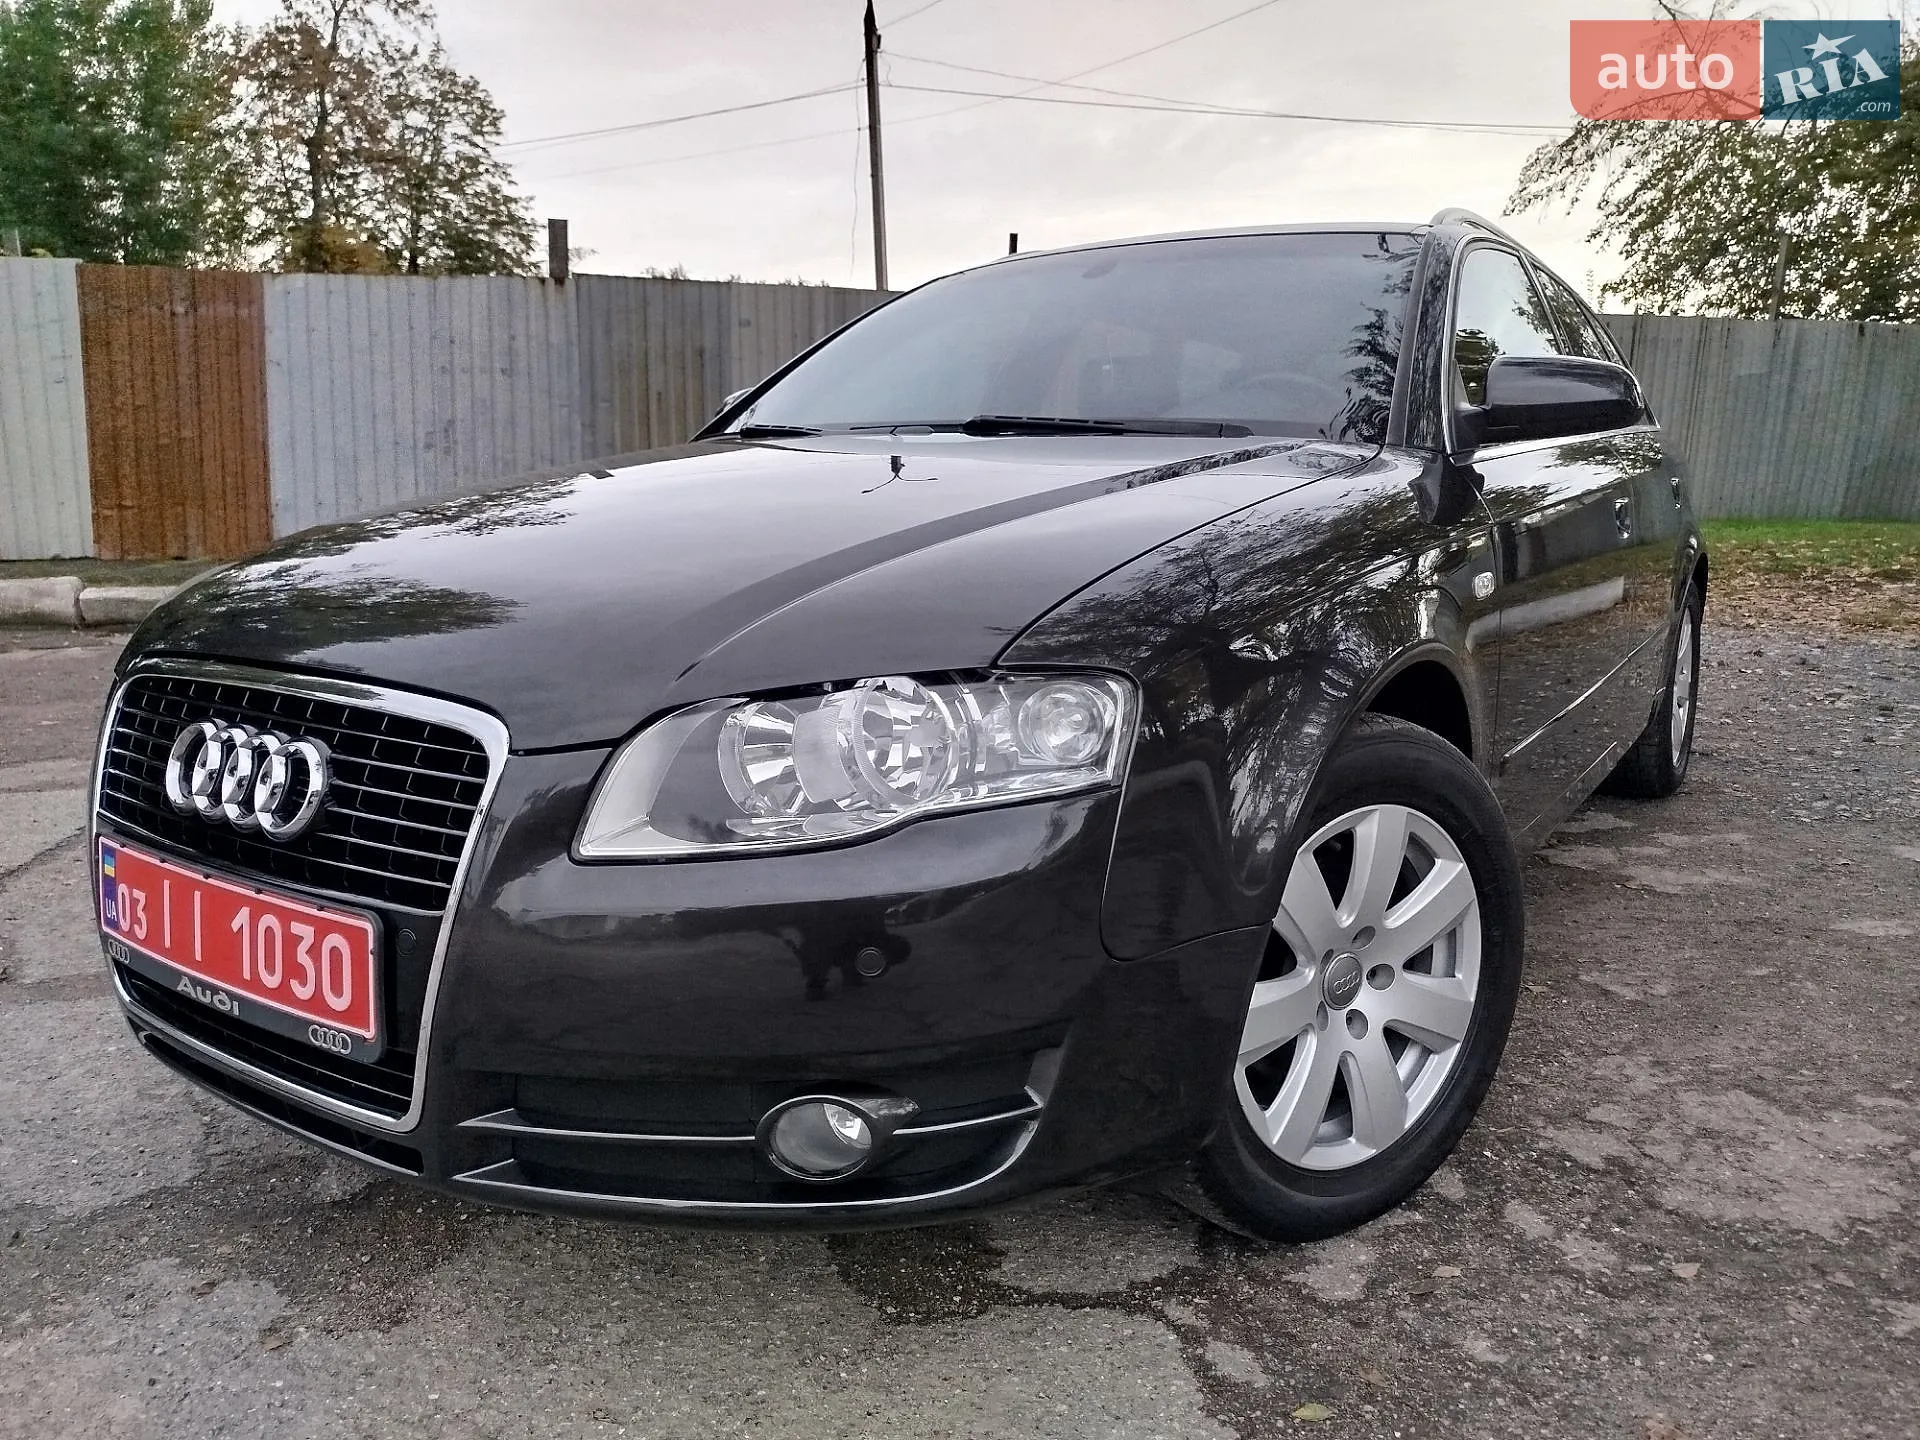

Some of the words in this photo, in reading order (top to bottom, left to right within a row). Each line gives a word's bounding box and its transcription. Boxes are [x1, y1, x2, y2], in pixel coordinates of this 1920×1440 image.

[105, 897, 118, 922] UA
[117, 883, 148, 940] 03
[230, 906, 352, 1012] 1030
[176, 976, 240, 1016] Audi
